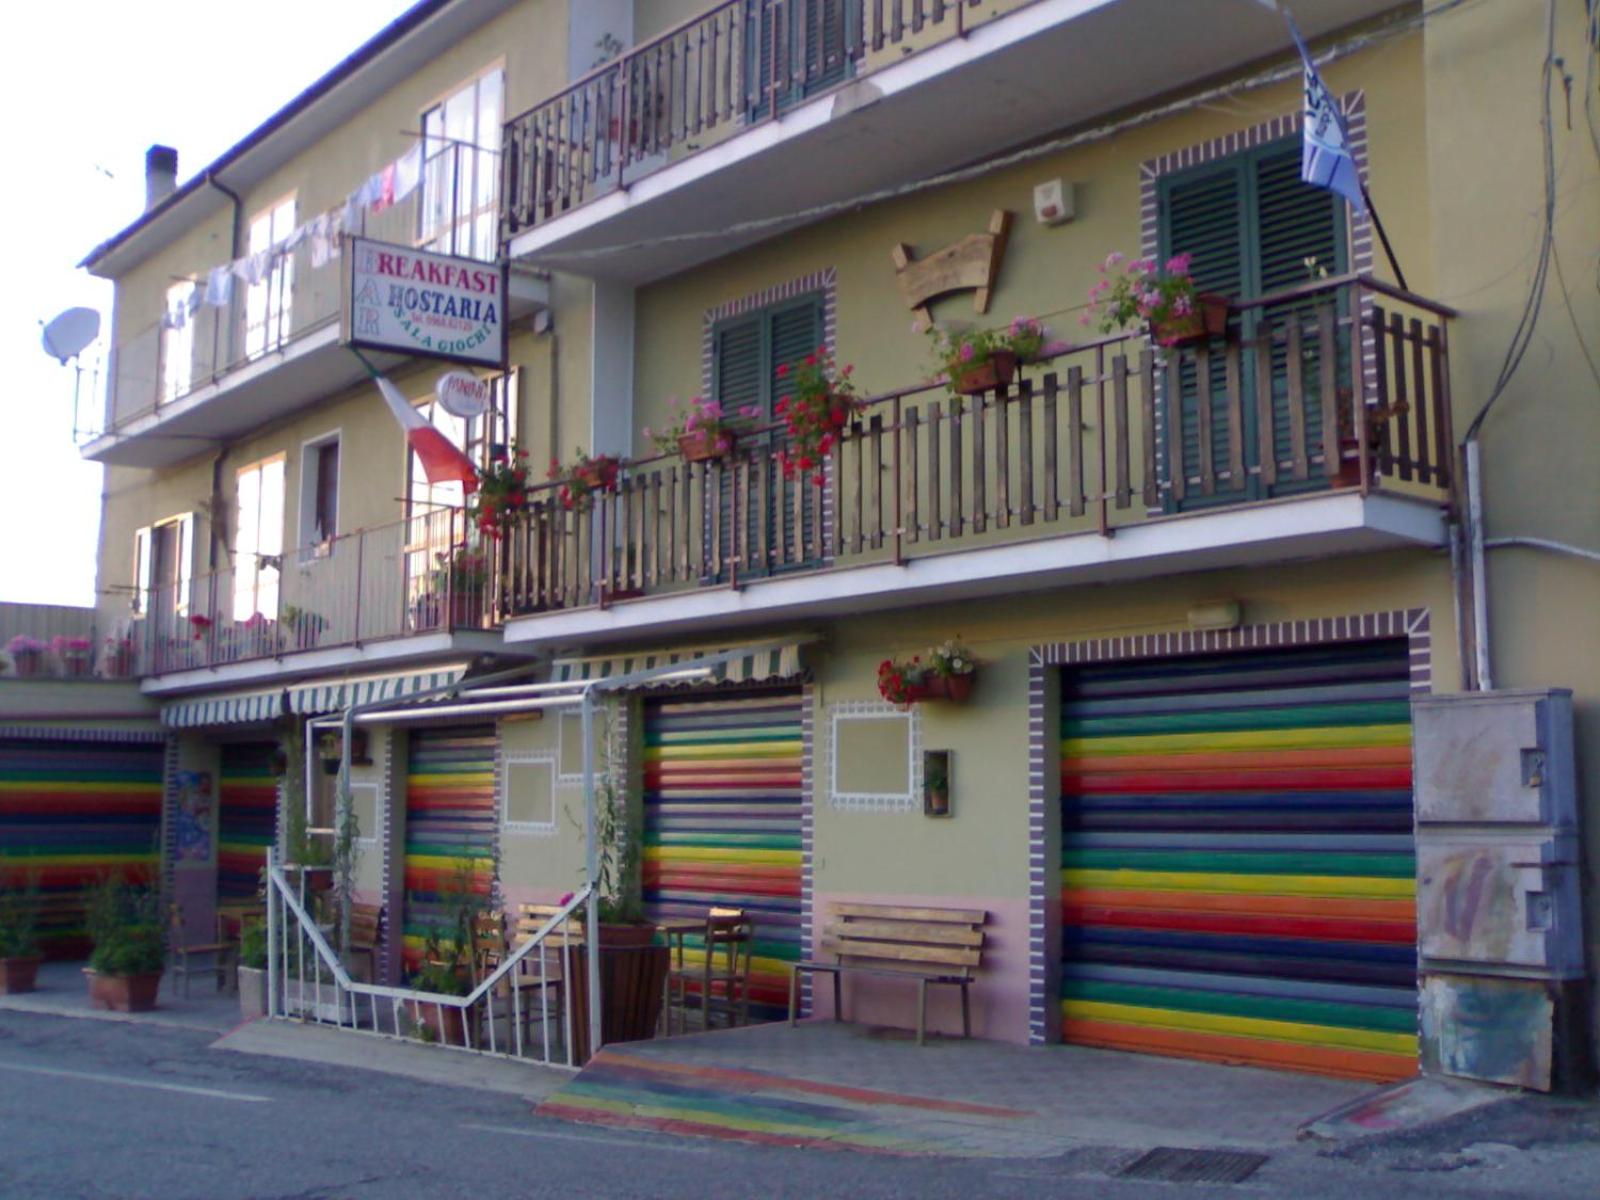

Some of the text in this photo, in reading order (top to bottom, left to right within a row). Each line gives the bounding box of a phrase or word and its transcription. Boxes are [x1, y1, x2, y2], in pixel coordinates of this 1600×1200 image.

[388, 284, 497, 323] HOSTARIA
[393, 307, 432, 347] SALA
[437, 324, 492, 353] GIOCHI
